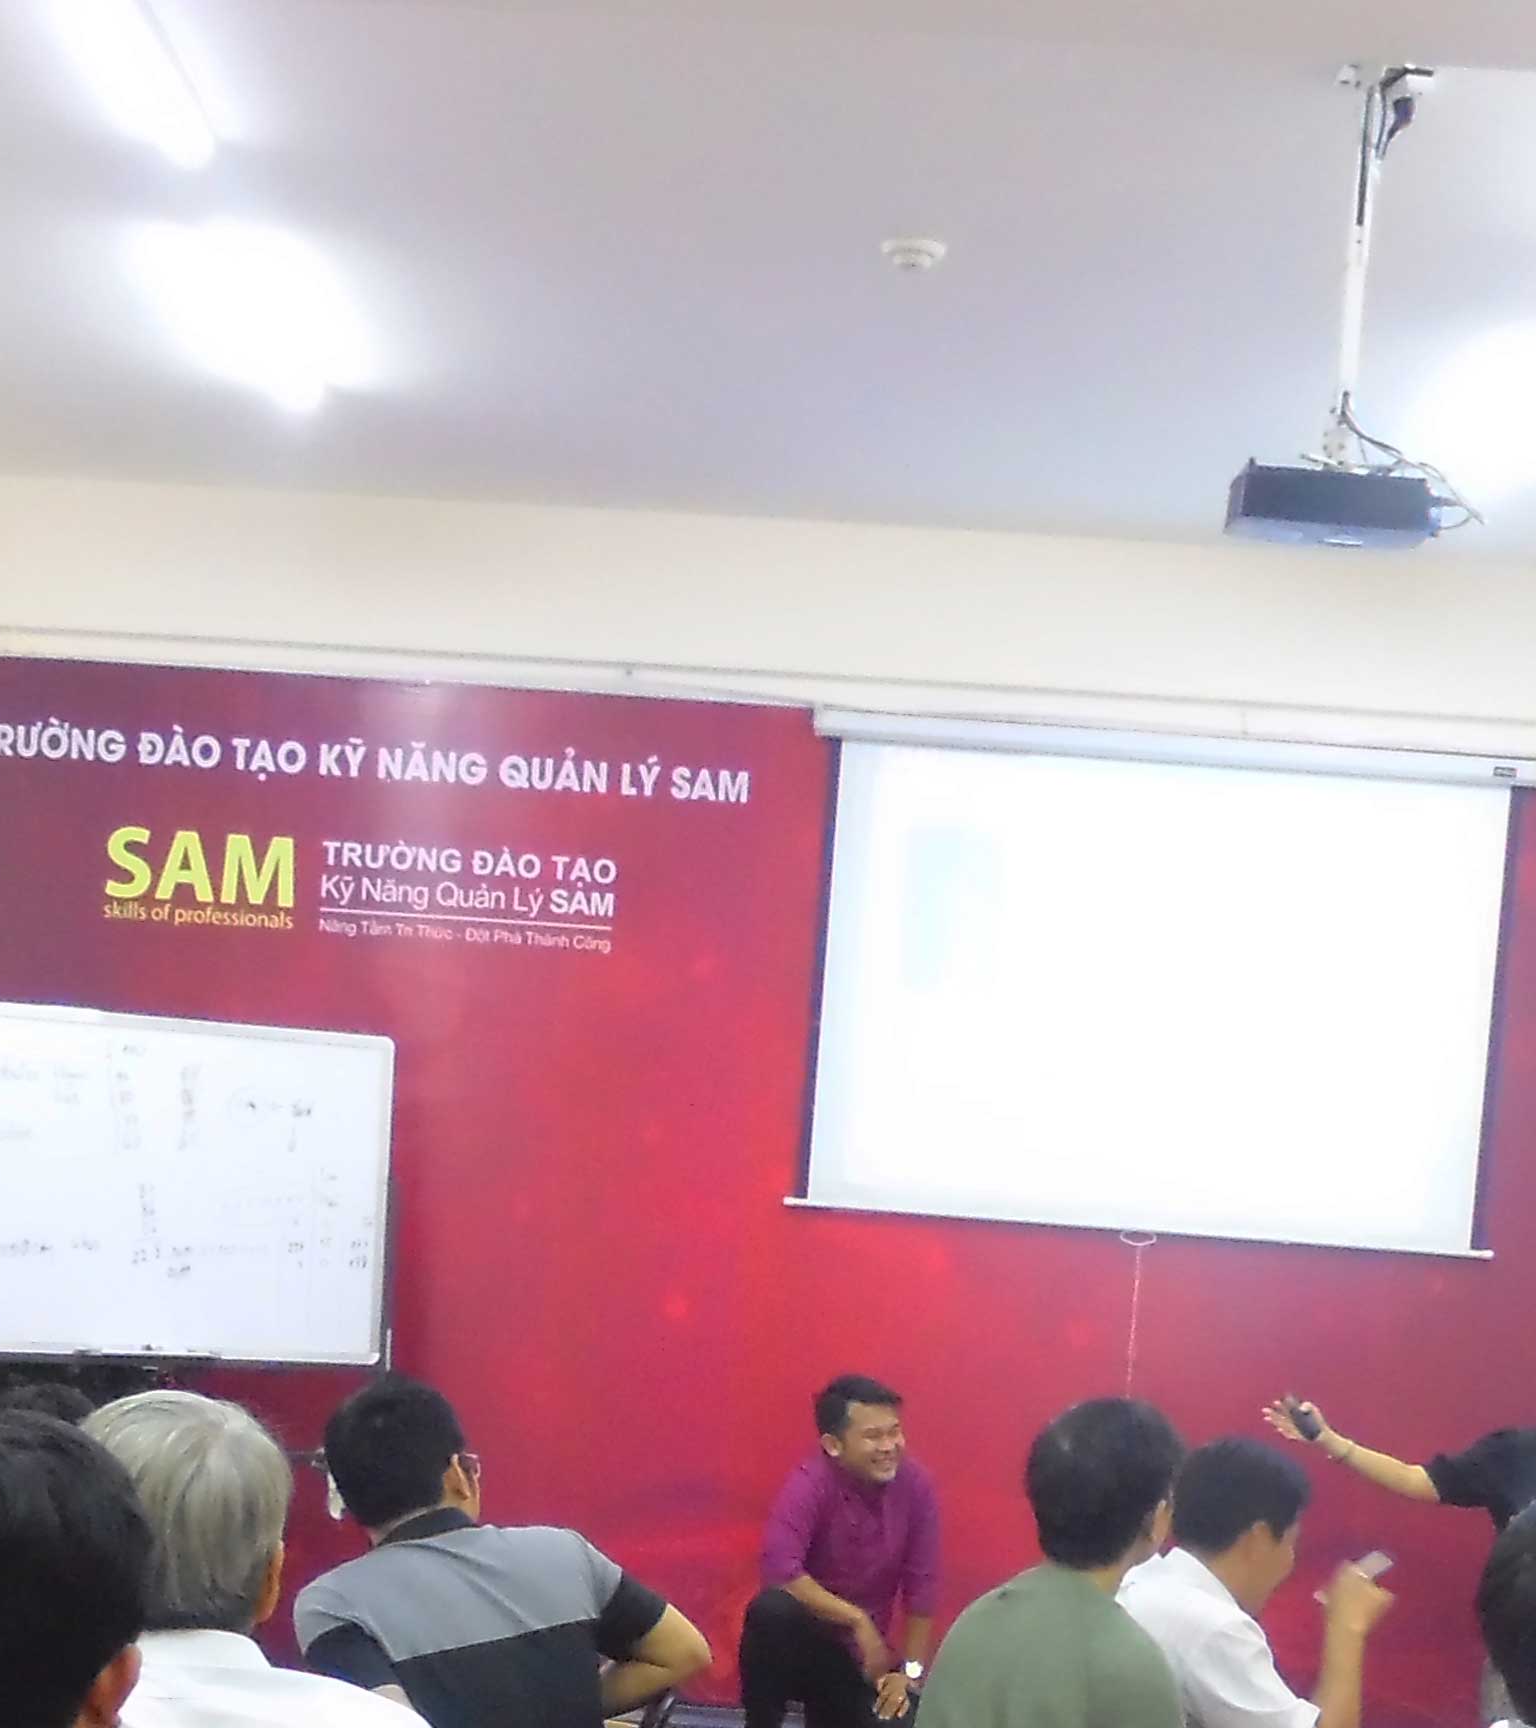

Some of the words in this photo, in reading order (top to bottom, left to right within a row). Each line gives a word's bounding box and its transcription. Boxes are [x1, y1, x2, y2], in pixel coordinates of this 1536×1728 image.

[137, 724, 221, 769] ĐÀO
[232, 737, 307, 782] TẠO
[319, 737, 366, 778] KỸ
[377, 741, 488, 786] NĂNG
[498, 746, 608, 793] QUẢN
[621, 755, 661, 797] LÝ
[671, 766, 750, 803] SAM
[104, 826, 294, 908] SAM
[322, 839, 462, 874] TRƯỜNG
[472, 845, 541, 879] ĐÀO
[551, 855, 617, 887] TẠO
[103, 901, 147, 921] skills
[151, 903, 172, 921] of
[174, 905, 295, 931] professionals
[320, 874, 355, 906] Kỹ
[361, 877, 430, 912] Năng
[435, 881, 506, 911] Quản
[513, 886, 545, 918] Lý
[550, 888, 615, 918] SAM
